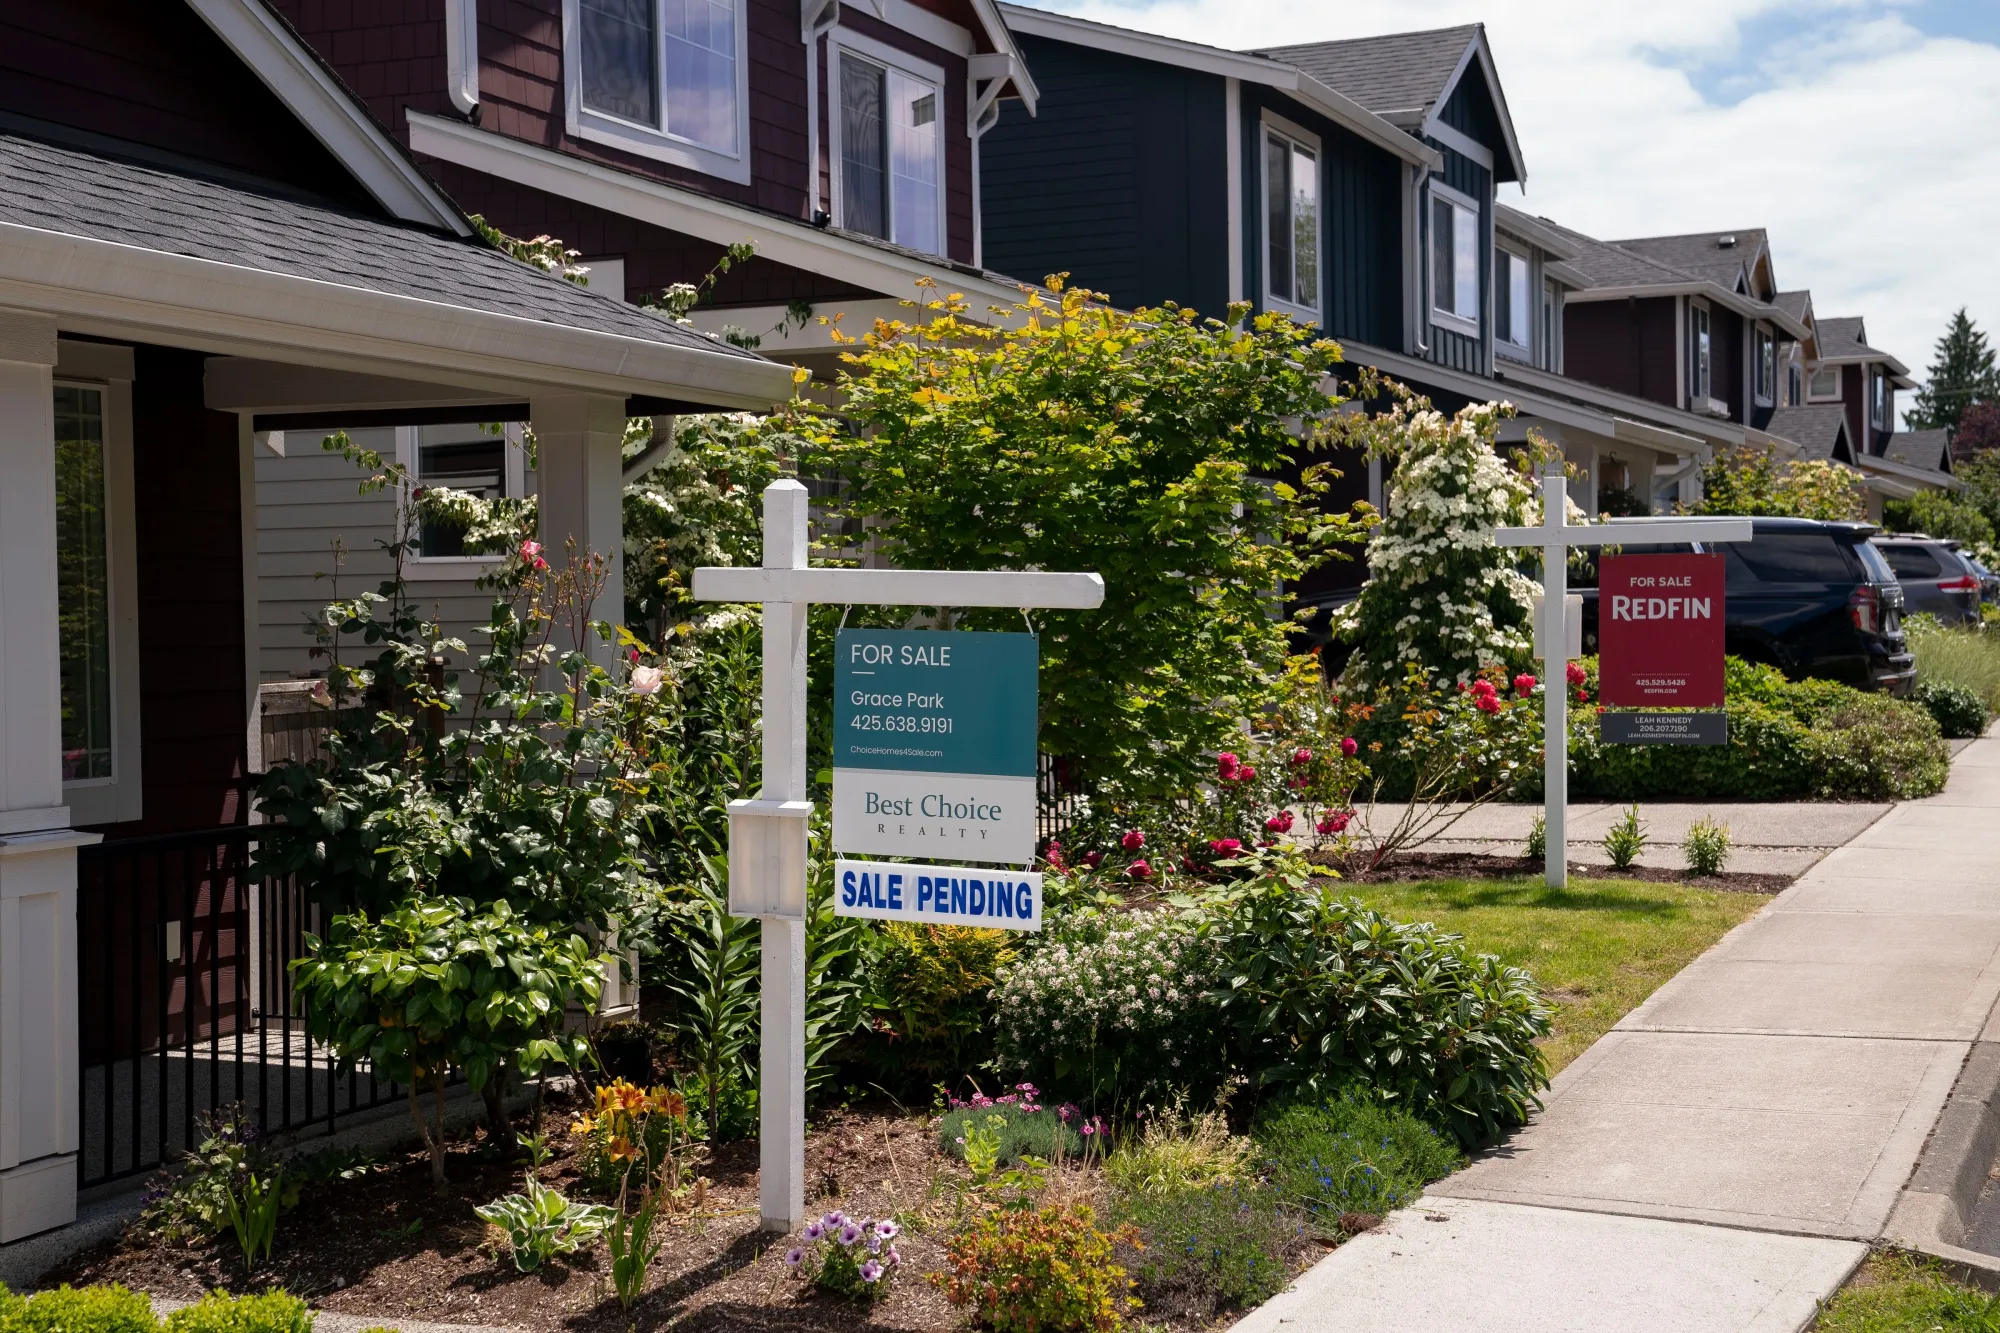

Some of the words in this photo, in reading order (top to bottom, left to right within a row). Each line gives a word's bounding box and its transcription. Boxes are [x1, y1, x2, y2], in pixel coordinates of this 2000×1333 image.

[1630, 577, 1655, 587] FOR
[1658, 576, 1692, 587] SALE
[1612, 595, 1711, 621] REDFIN
[851, 644, 893, 665] FOR
[900, 645, 951, 667] SALE
[851, 691, 903, 707] Grace
[907, 692, 944, 709] Park
[850, 714, 953, 734] 425.638.9191
[1635, 716, 1655, 724] LEAH
[850, 745, 943, 757] ChoiceHomes4Sale.com
[865, 791, 913, 816] Best
[920, 794, 1002, 821] Choice
[877, 823, 988, 840] REALTY
[842, 870, 903, 910] SALE
[917, 876, 1033, 920] PENDING
